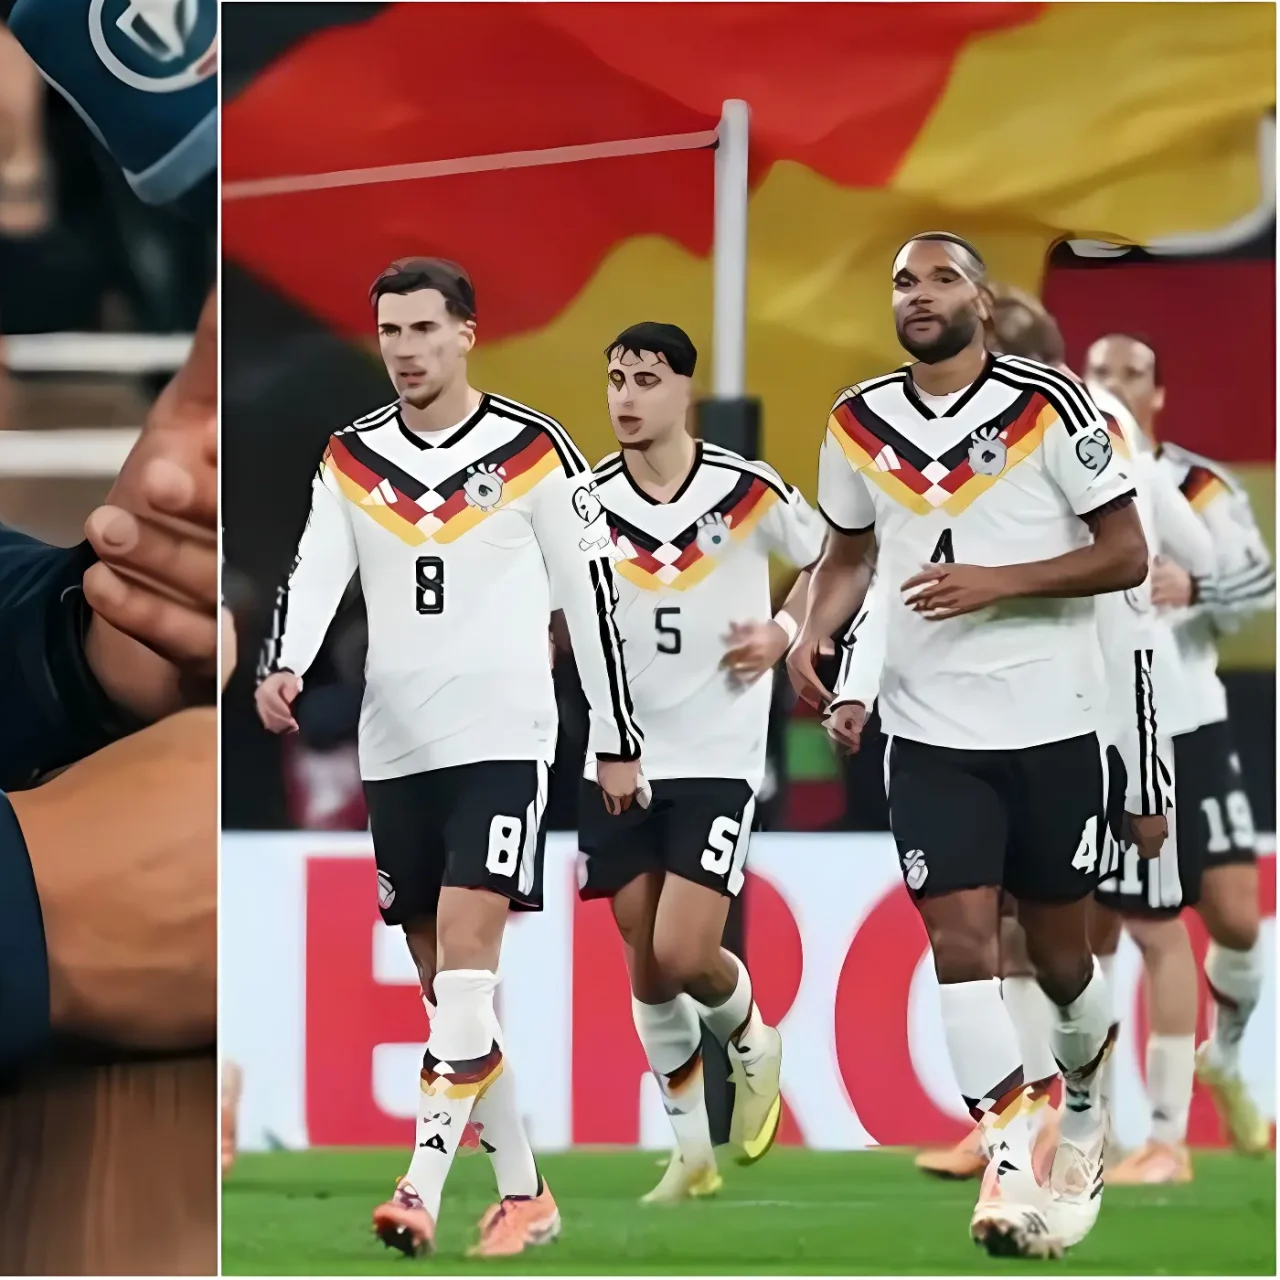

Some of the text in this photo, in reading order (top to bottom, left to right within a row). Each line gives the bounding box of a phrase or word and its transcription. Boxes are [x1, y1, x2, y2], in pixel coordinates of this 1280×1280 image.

[415, 556, 445, 615] 8
[654, 606, 682, 655] 5
[485, 814, 522, 877] 8
